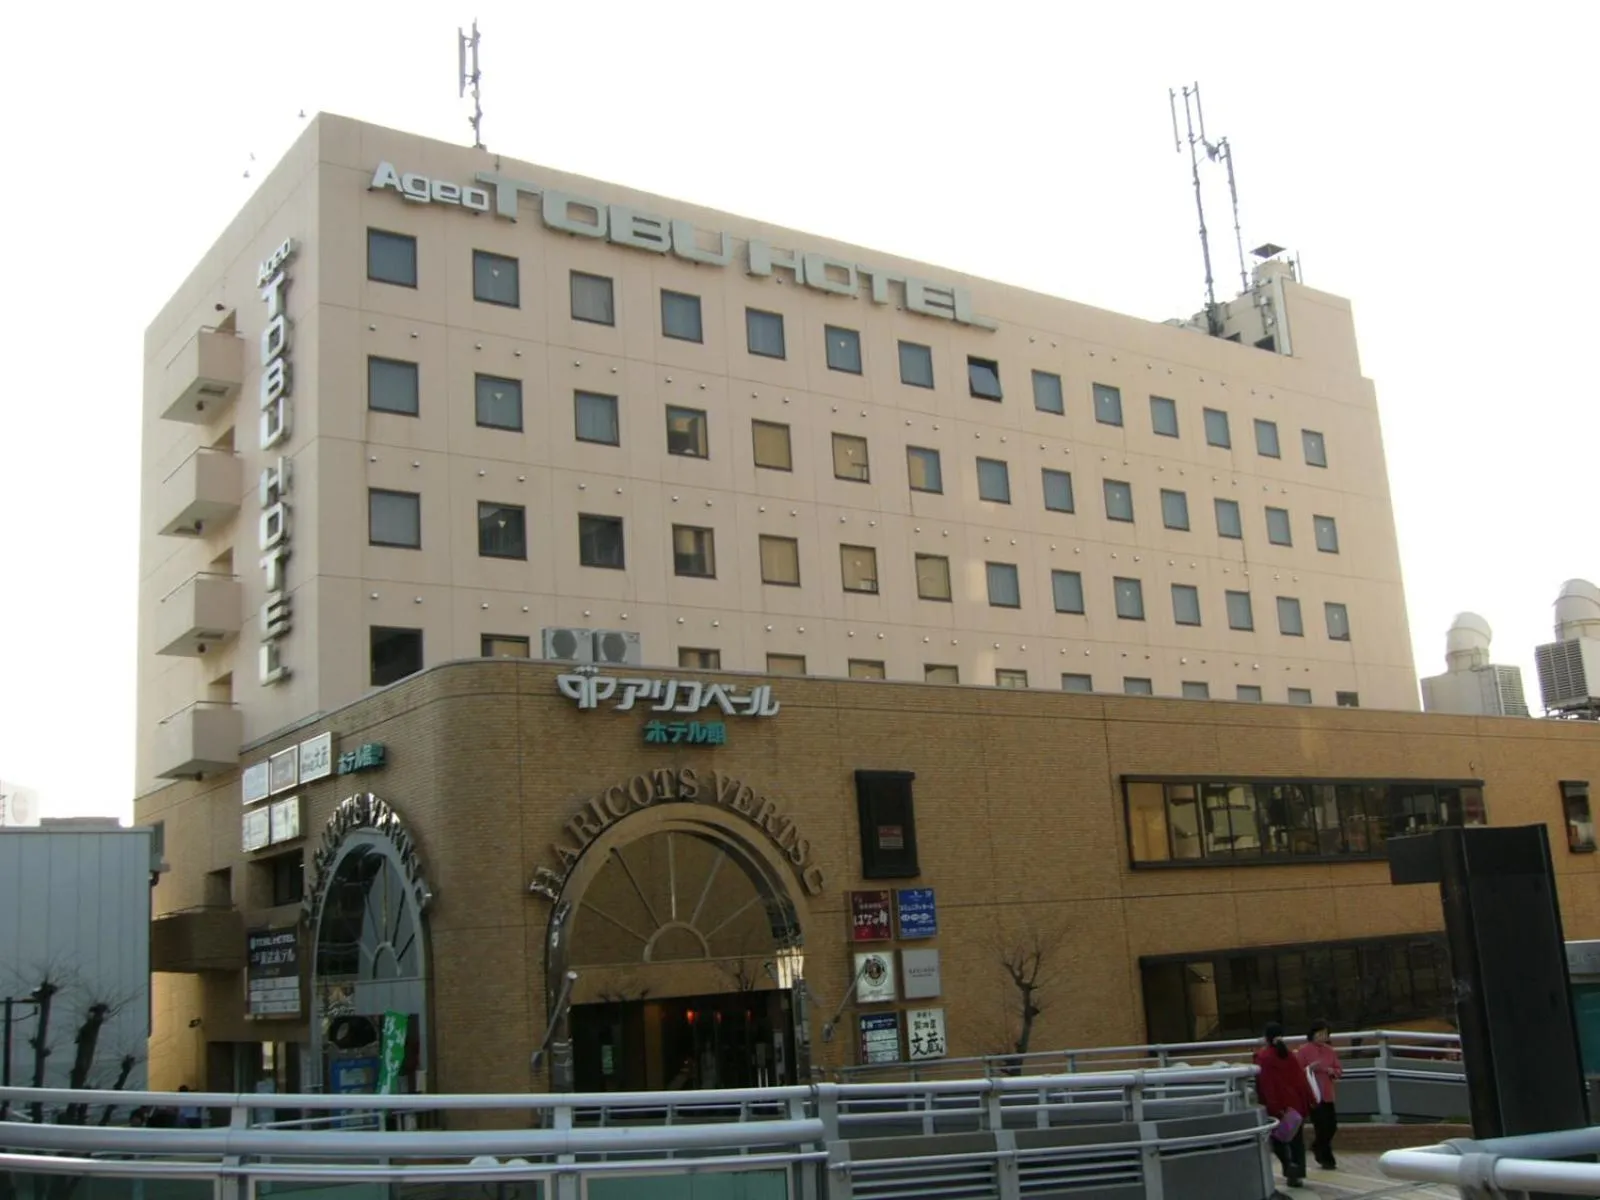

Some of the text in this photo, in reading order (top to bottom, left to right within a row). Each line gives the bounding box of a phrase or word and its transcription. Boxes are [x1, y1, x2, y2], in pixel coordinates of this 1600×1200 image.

[369, 160, 998, 332] Ageo TOBU HOTEL
[259, 272, 291, 450] TOBU
[258, 456, 291, 686] HOTEL
[613, 677, 781, 717] アリコベール
[644, 719, 727, 745] ホテル館
